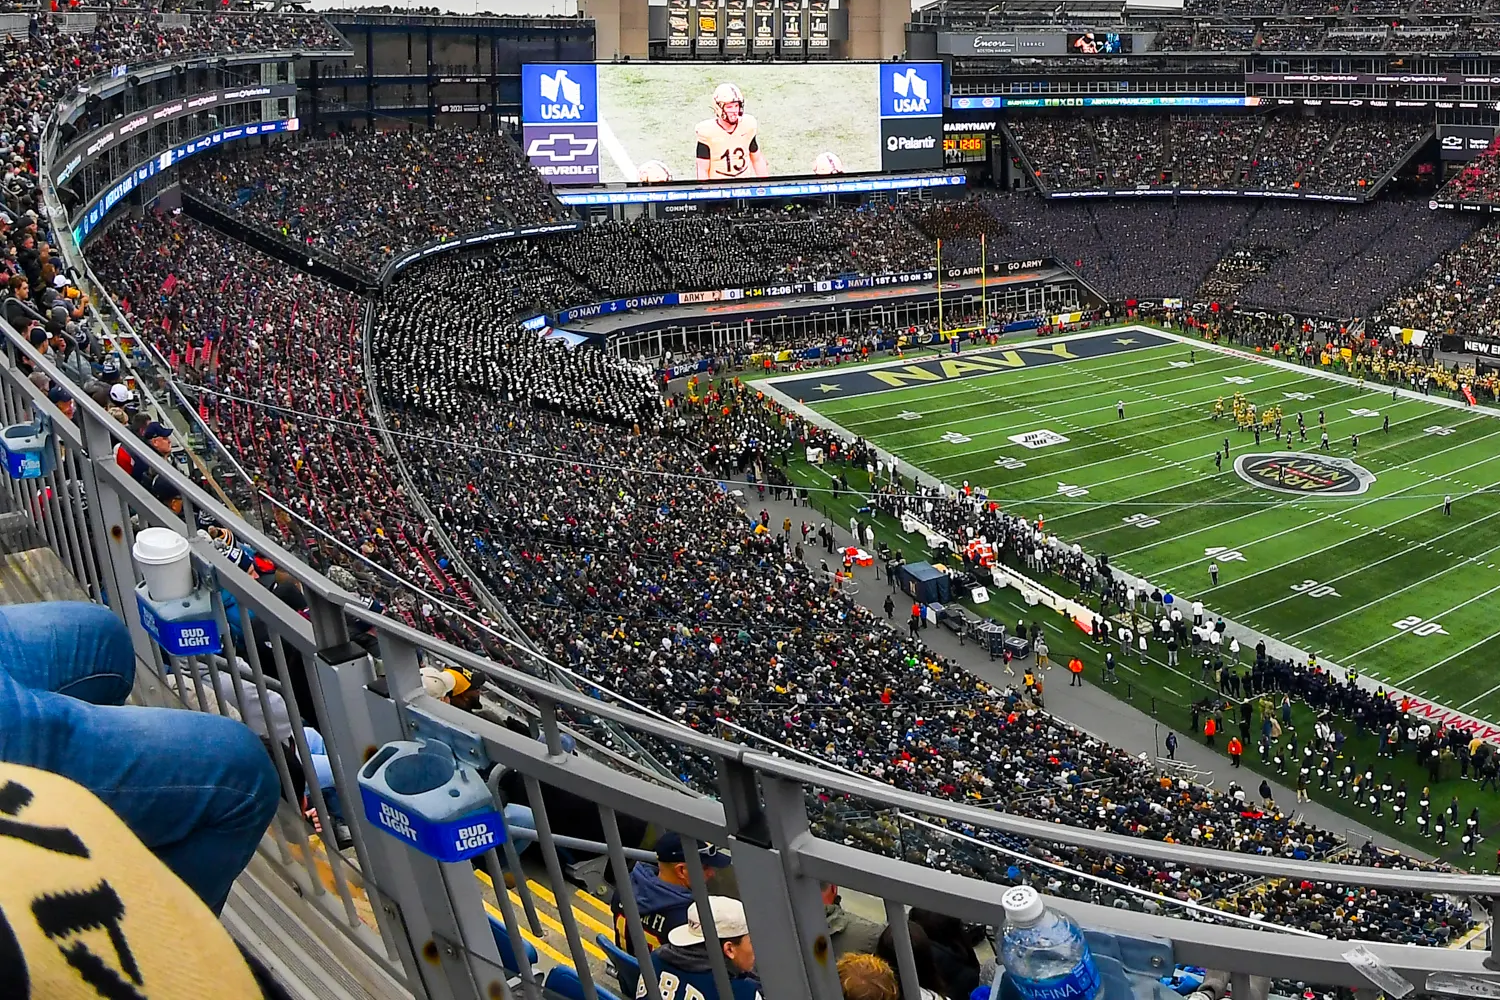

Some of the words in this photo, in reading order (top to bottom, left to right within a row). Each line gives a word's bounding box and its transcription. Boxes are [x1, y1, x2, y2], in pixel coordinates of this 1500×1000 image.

[973, 36, 1015, 48] Encore
[540, 104, 581, 119] USAA
[894, 99, 928, 113] USAA
[943, 122, 997, 131] #ARMYNAVY
[898, 136, 936, 149] Palantir
[959, 138, 982, 150] 12:06
[720, 147, 747, 172] 13
[537, 165, 599, 175] HEVROLET
[665, 204, 697, 213] COMMNS
[949, 269, 961, 277] GO
[962, 266, 984, 276] ARMY
[1007, 262, 1020, 271] GO
[1021, 259, 1043, 269] ARMY
[848, 278, 869, 288] NAVY
[875, 277, 890, 285] 1ST
[891, 275, 897, 283] &
[899, 274, 909, 283] 10
[910, 273, 921, 281] ON
[923, 272, 933, 280] 39
[752, 288, 762, 296] 34
[766, 286, 791, 296] 12:06
[822, 282, 828, 290] 0
[683, 292, 705, 302] ARMY
[729, 289, 736, 298] 0
[625, 298, 639, 309] GO
[640, 296, 665, 307] NAVY
[568, 308, 579, 319] GO
[579, 305, 602, 318] NAVY
[1464, 340, 1490, 353] NEW
[868, 343, 1080, 387] NAVY
[1278, 460, 1341, 481] NAVY
[1258, 465, 1327, 490] ARMY
[1057, 484, 1090, 498] 40
[1122, 513, 1161, 529] 50
[1204, 546, 1241, 563] 40
[1290, 579, 1334, 599] 30
[1391, 615, 1442, 637] 20
[180, 628, 204, 638] BUD
[178, 636, 210, 648] LIGHT
[380, 801, 410, 828] BUD
[379, 811, 418, 843] LIGHT
[458, 823, 488, 841] BUD
[455, 832, 495, 852] LIGHT
[651, 915, 666, 933] FI
